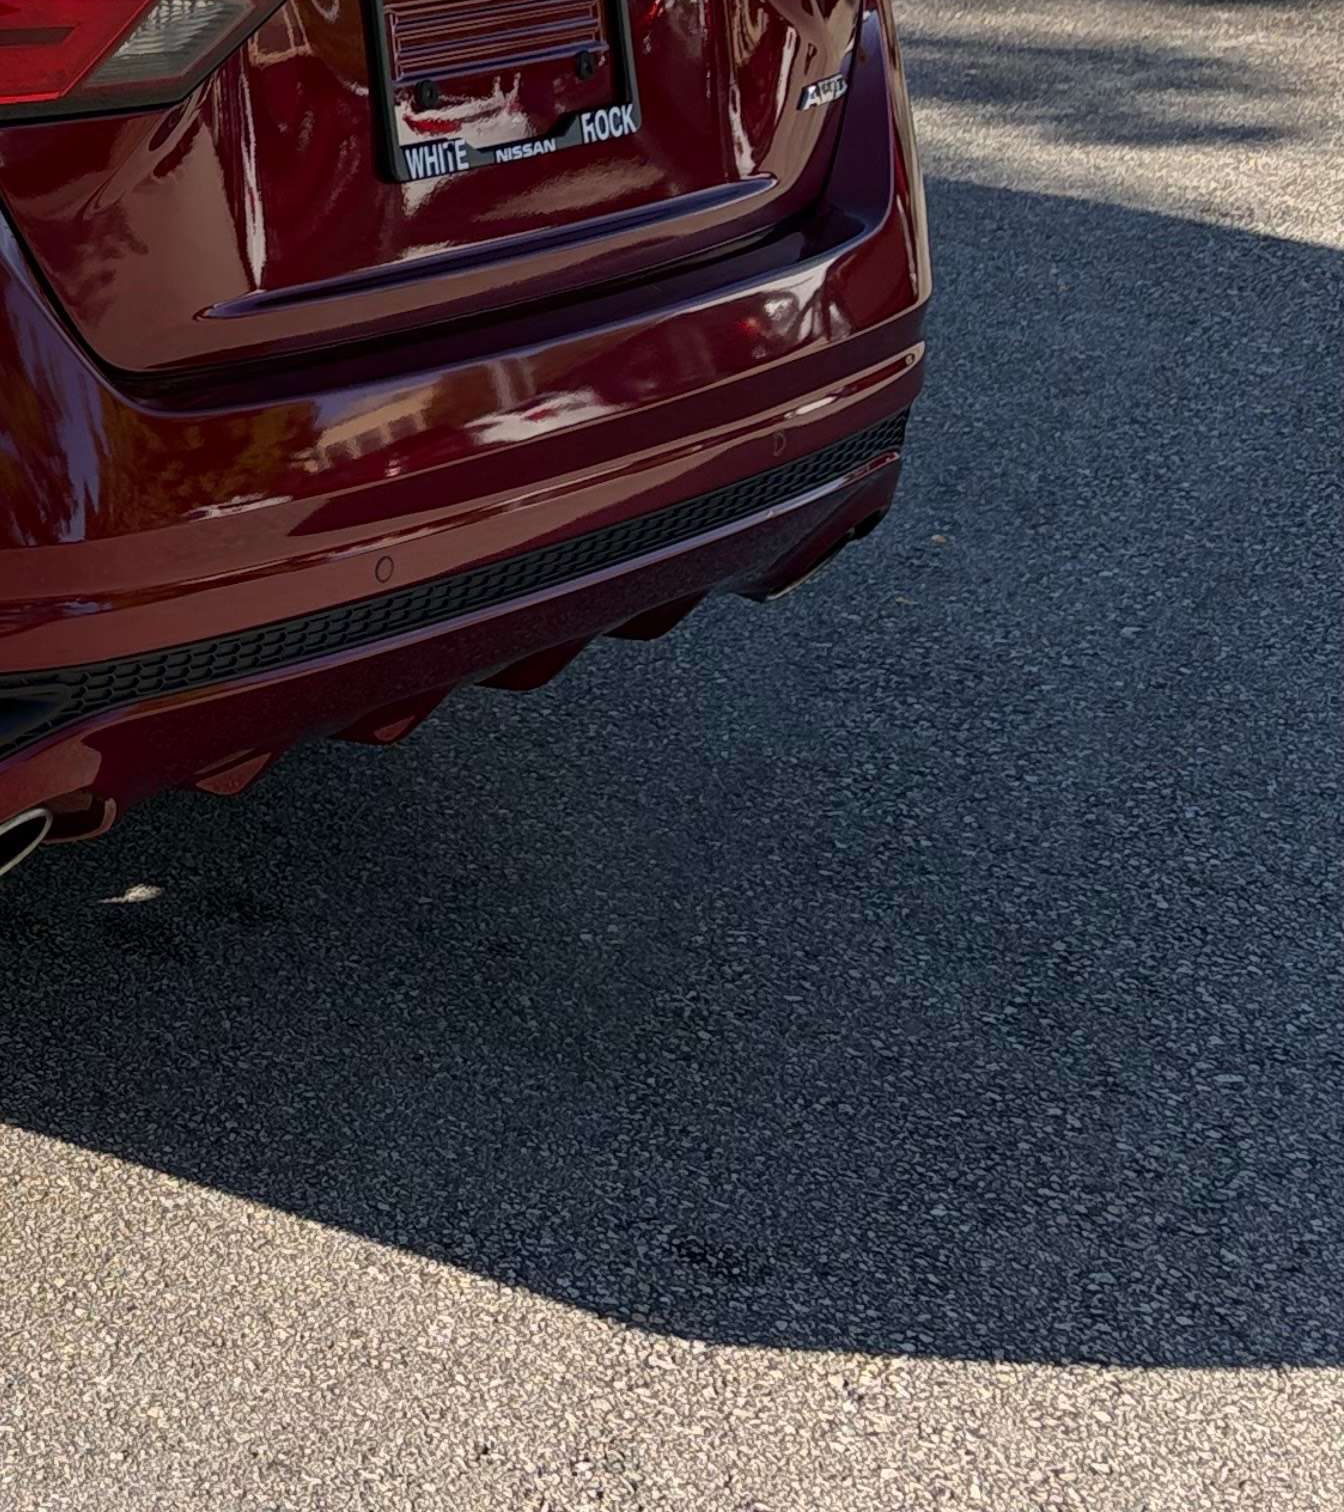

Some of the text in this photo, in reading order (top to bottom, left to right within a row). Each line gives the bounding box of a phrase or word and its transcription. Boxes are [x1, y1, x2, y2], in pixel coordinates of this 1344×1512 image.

[580, 103, 638, 145] ROCK
[404, 138, 557, 180] WHITE NISSAN
